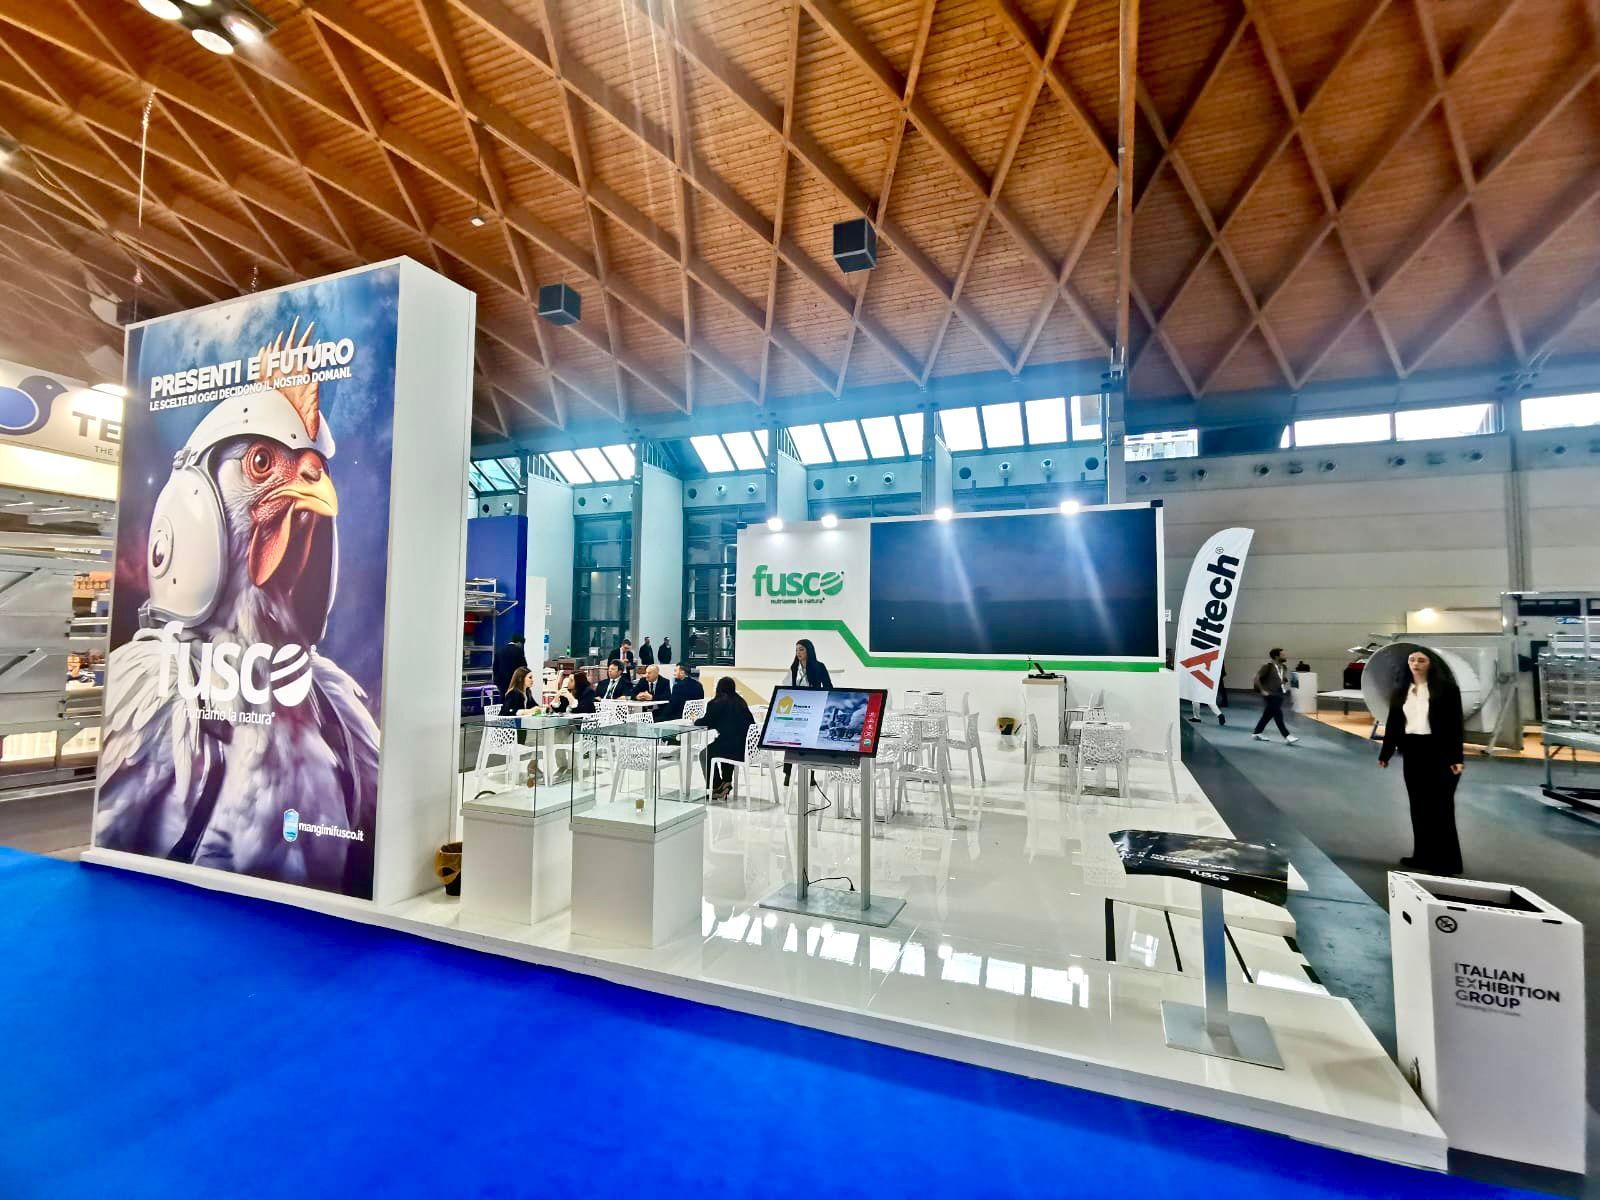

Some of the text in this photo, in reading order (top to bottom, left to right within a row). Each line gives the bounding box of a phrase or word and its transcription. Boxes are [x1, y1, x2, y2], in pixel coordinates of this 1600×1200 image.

[150, 338, 354, 399] PRESENTI E FUTURO
[149, 401, 160, 412] LE
[160, 396, 188, 410] SCELTE
[188, 394, 197, 405] DI
[197, 390, 218, 403] OGGI
[219, 382, 262, 400] DECIDONO
[264, 380, 273, 391] IL
[273, 374, 311, 390] NOSTRO
[752, 564, 843, 597] fusco
[157, 621, 312, 707] fusco
[299, 822, 364, 842] mangimifusco.it
[1455, 962, 1525, 984] ITALIAN
[1455, 975, 1560, 1003] EXHIBITION
[1455, 989, 1520, 1009] GROUP
